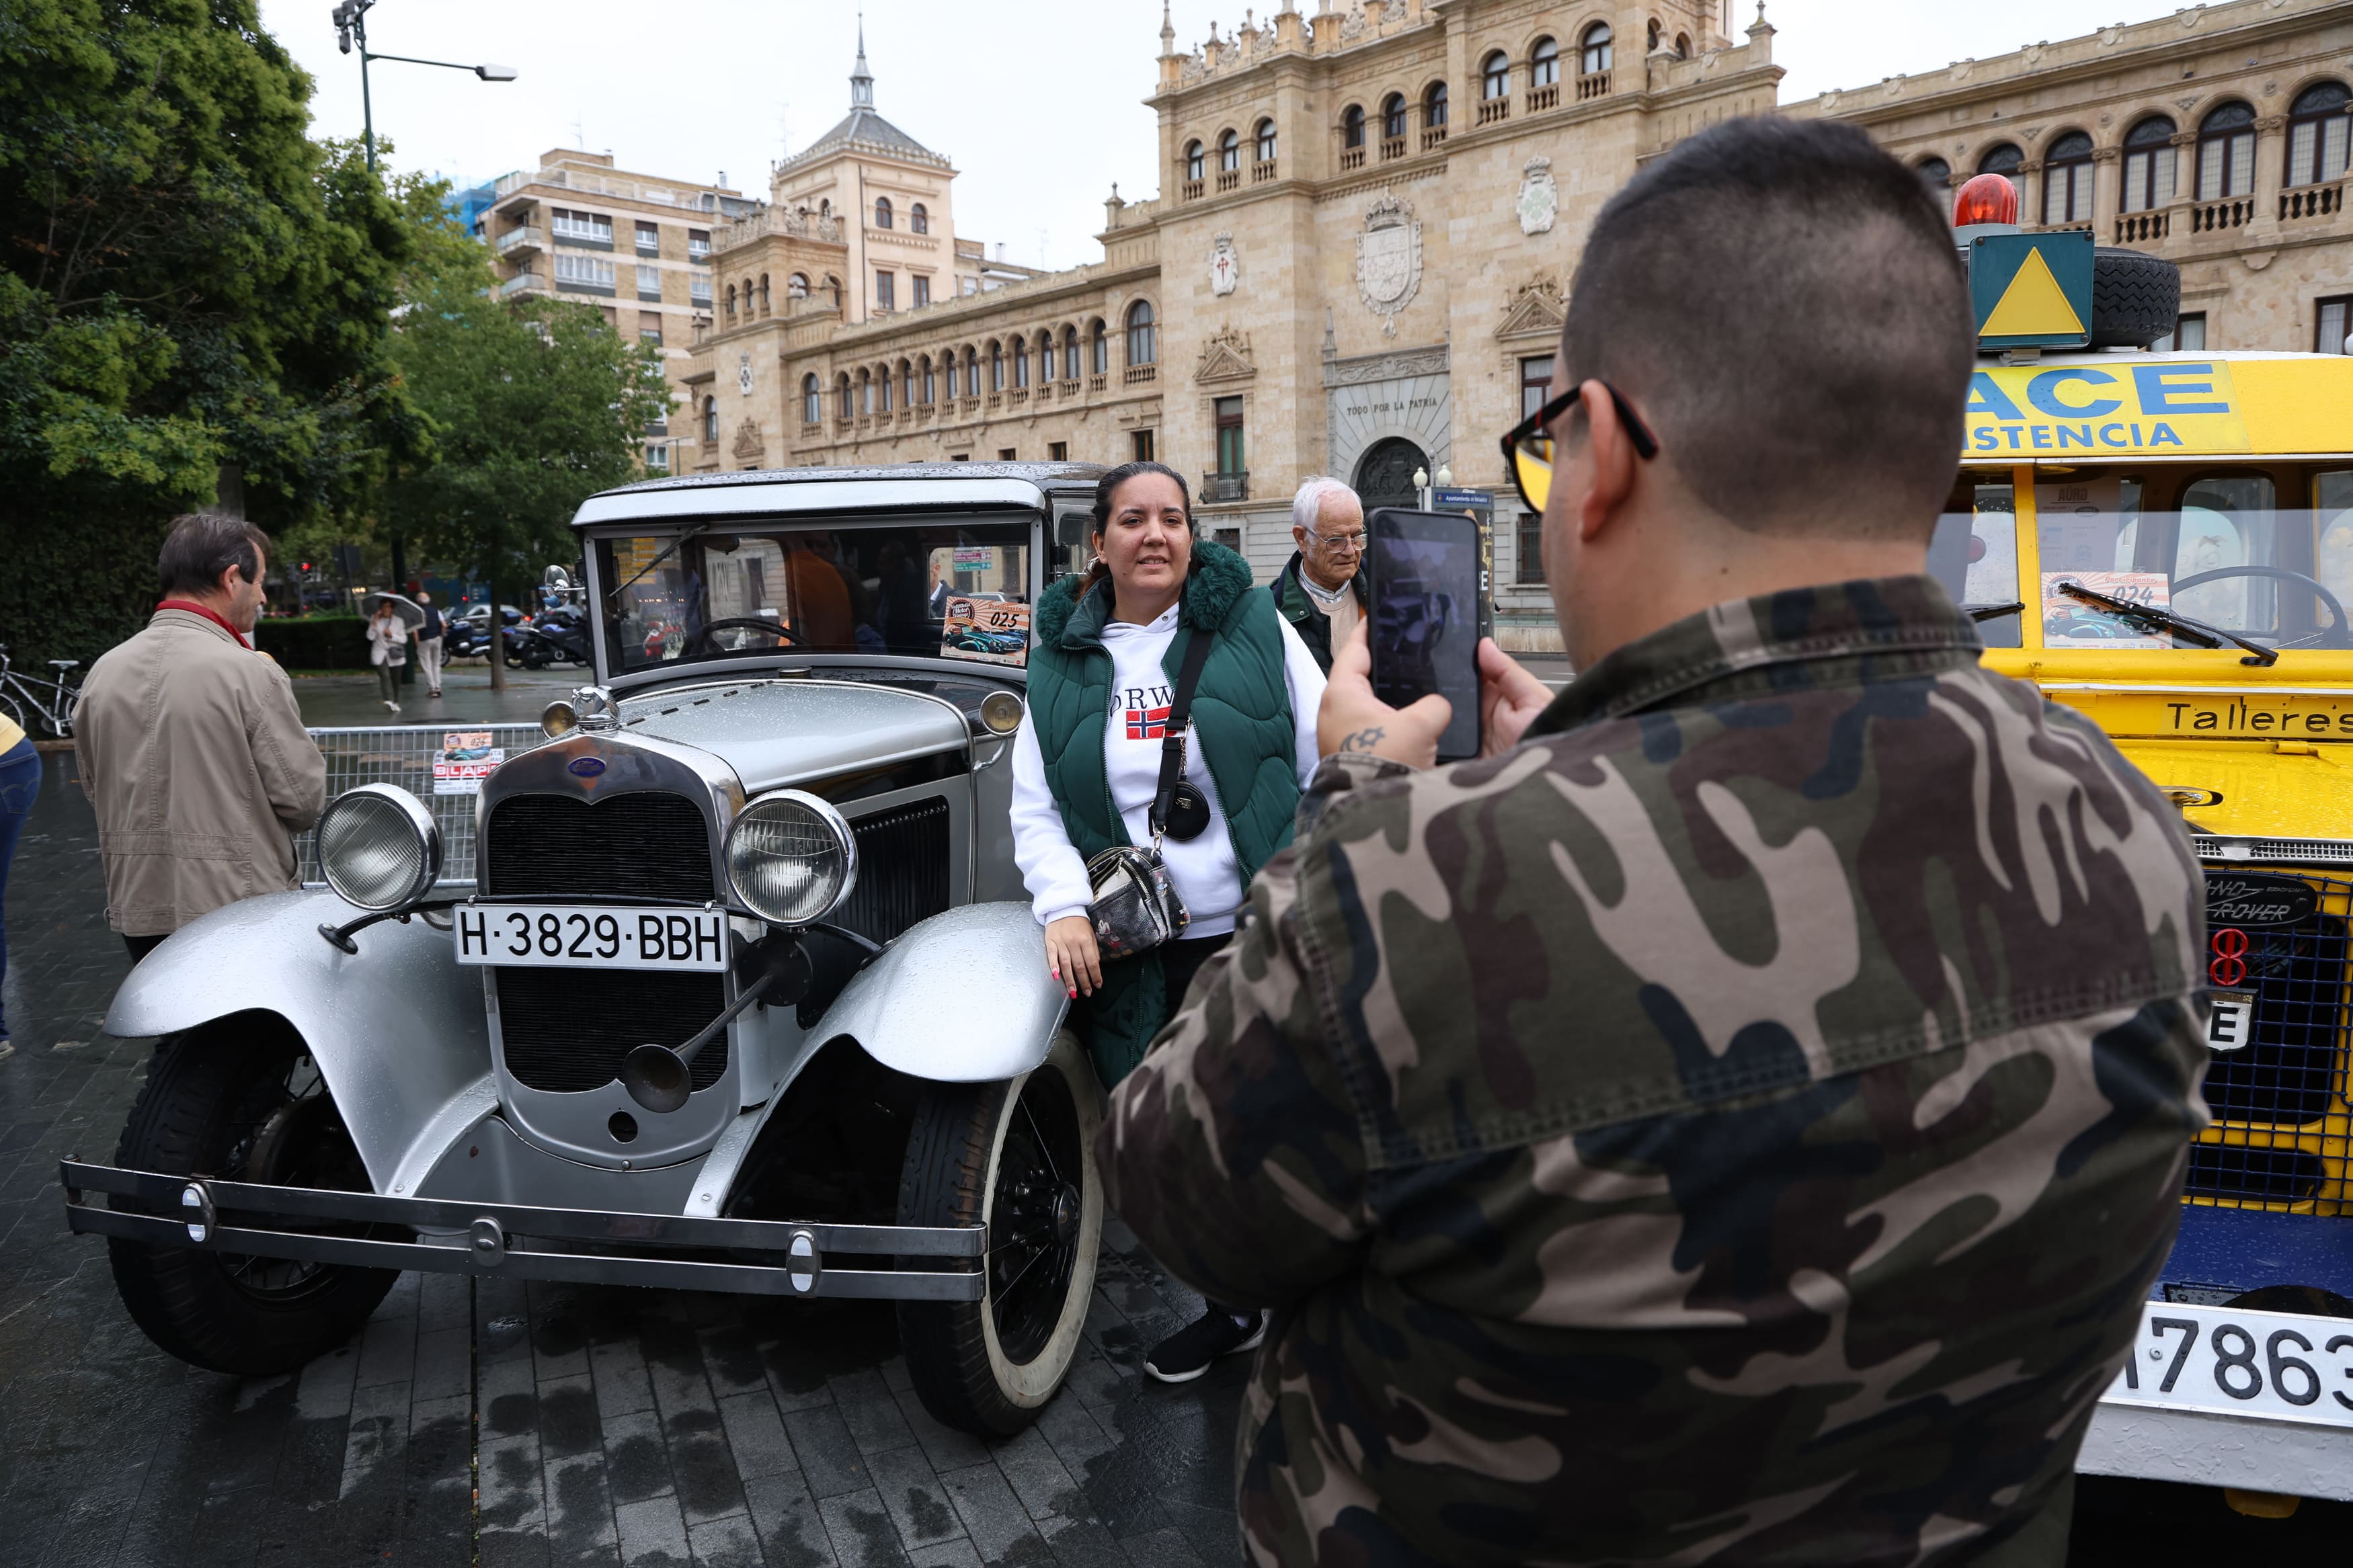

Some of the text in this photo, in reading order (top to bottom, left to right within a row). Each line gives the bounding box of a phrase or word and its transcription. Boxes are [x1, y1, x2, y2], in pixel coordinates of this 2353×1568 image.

[1347, 398, 1437, 415] TODO POR LA PATRIA
[990, 612, 1020, 628] 025
[2167, 703, 2353, 733] Talleres
[434, 766, 491, 776] BLAP
[2213, 903, 2291, 921] ROVER
[2210, 1006, 2241, 1042] E
